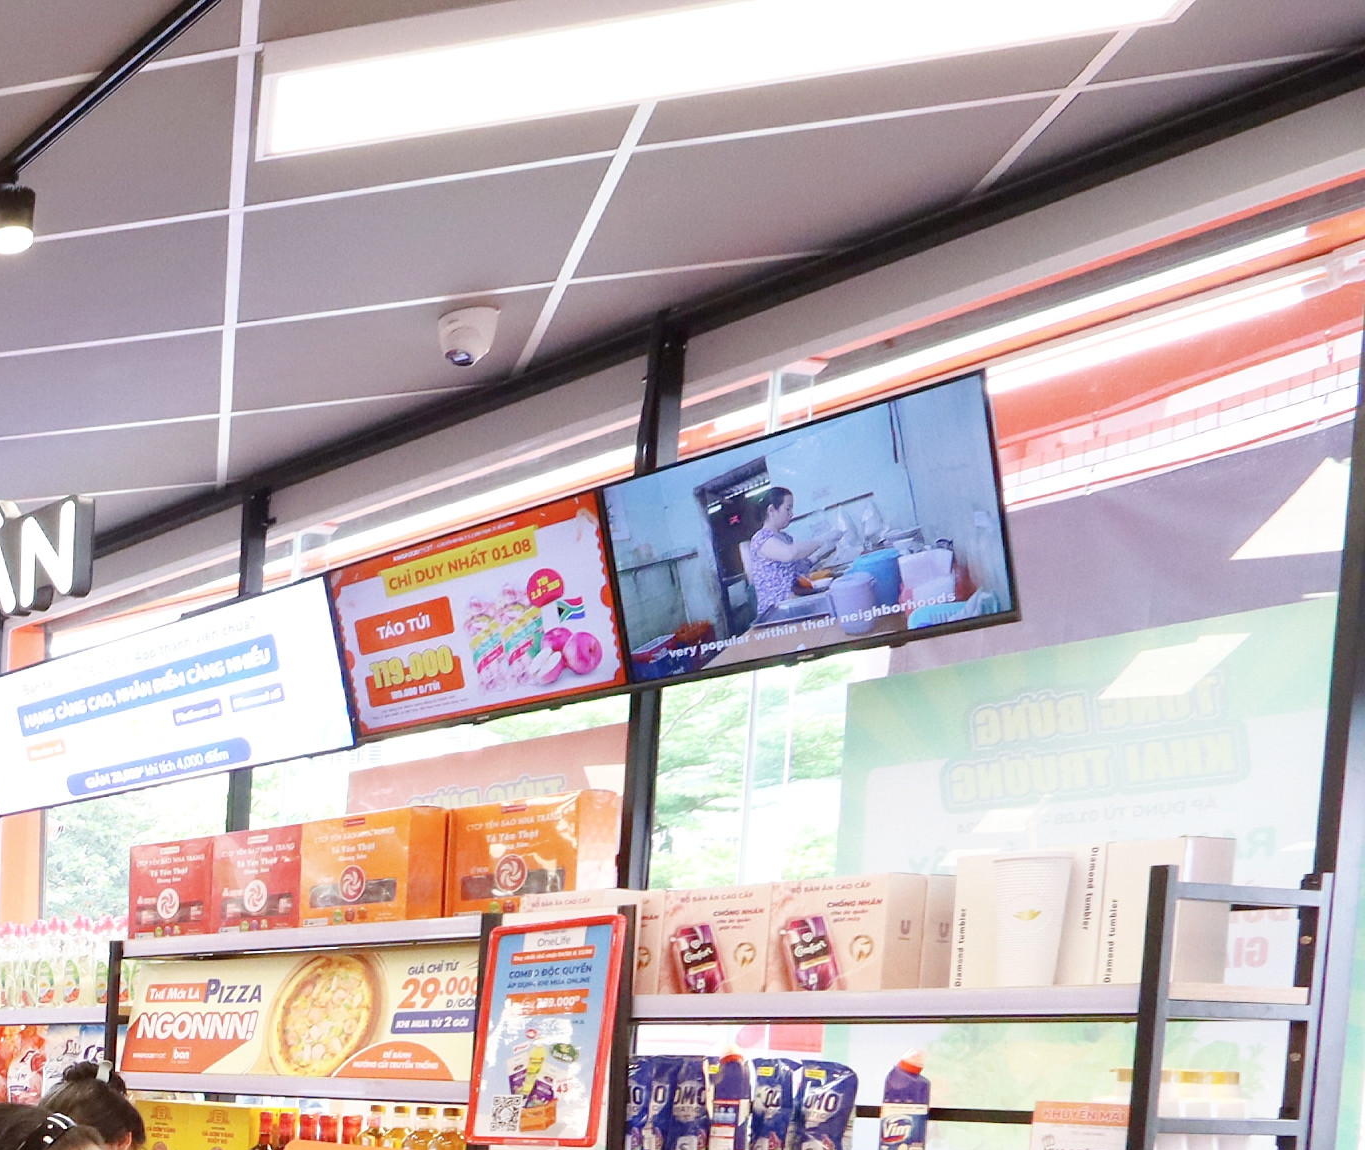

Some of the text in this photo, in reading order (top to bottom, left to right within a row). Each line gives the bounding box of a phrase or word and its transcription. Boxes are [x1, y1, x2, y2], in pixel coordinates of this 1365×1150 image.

[389, 570, 411, 591] CHỈ
[416, 564, 444, 584] DUY
[448, 548, 487, 574] NHẤT
[492, 538, 532, 562] 01.08
[376, 612, 431, 640] TÁO TÚI
[669, 591, 956, 660] very popular within their neighborhoods
[370, 645, 454, 690] 119.000
[1082, 846, 1100, 931] Diamond tumbler
[537, 935, 572, 948] OneLife
[955, 908, 967, 987] Diamond tumbler
[1103, 899, 1118, 984] Diamond tumbler
[408, 959, 459, 976] GIÁ CHỈ TỪ
[204, 979, 262, 1004] PIZZA
[136, 1010, 259, 1041] NGONNN!
[1043, 1105, 1126, 1123] KHUYẾN MÃI
[882, 1120, 912, 1141] Vim
